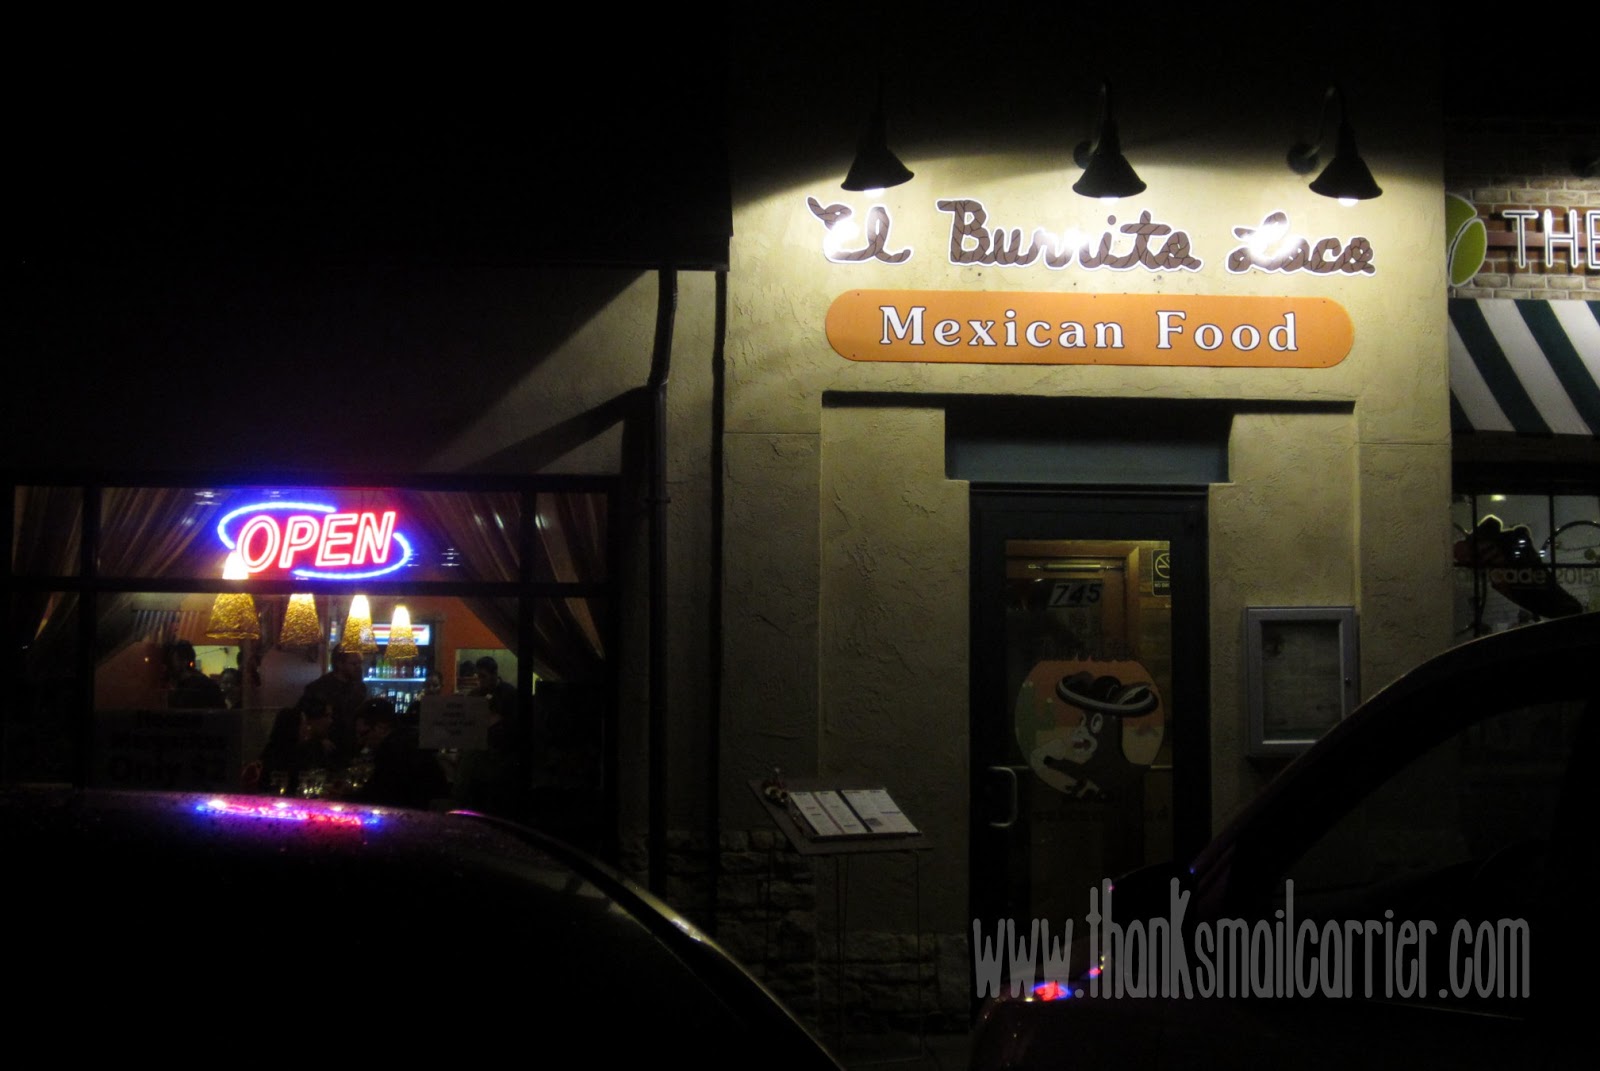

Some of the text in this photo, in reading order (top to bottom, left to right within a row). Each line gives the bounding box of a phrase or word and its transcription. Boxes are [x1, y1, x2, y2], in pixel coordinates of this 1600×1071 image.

[807, 196, 1376, 275] El Burrito Loco
[1502, 209, 1600, 269] THE
[879, 305, 1299, 352] Mexican Food
[236, 511, 397, 573] OPEN
[1053, 583, 1103, 605] 745
